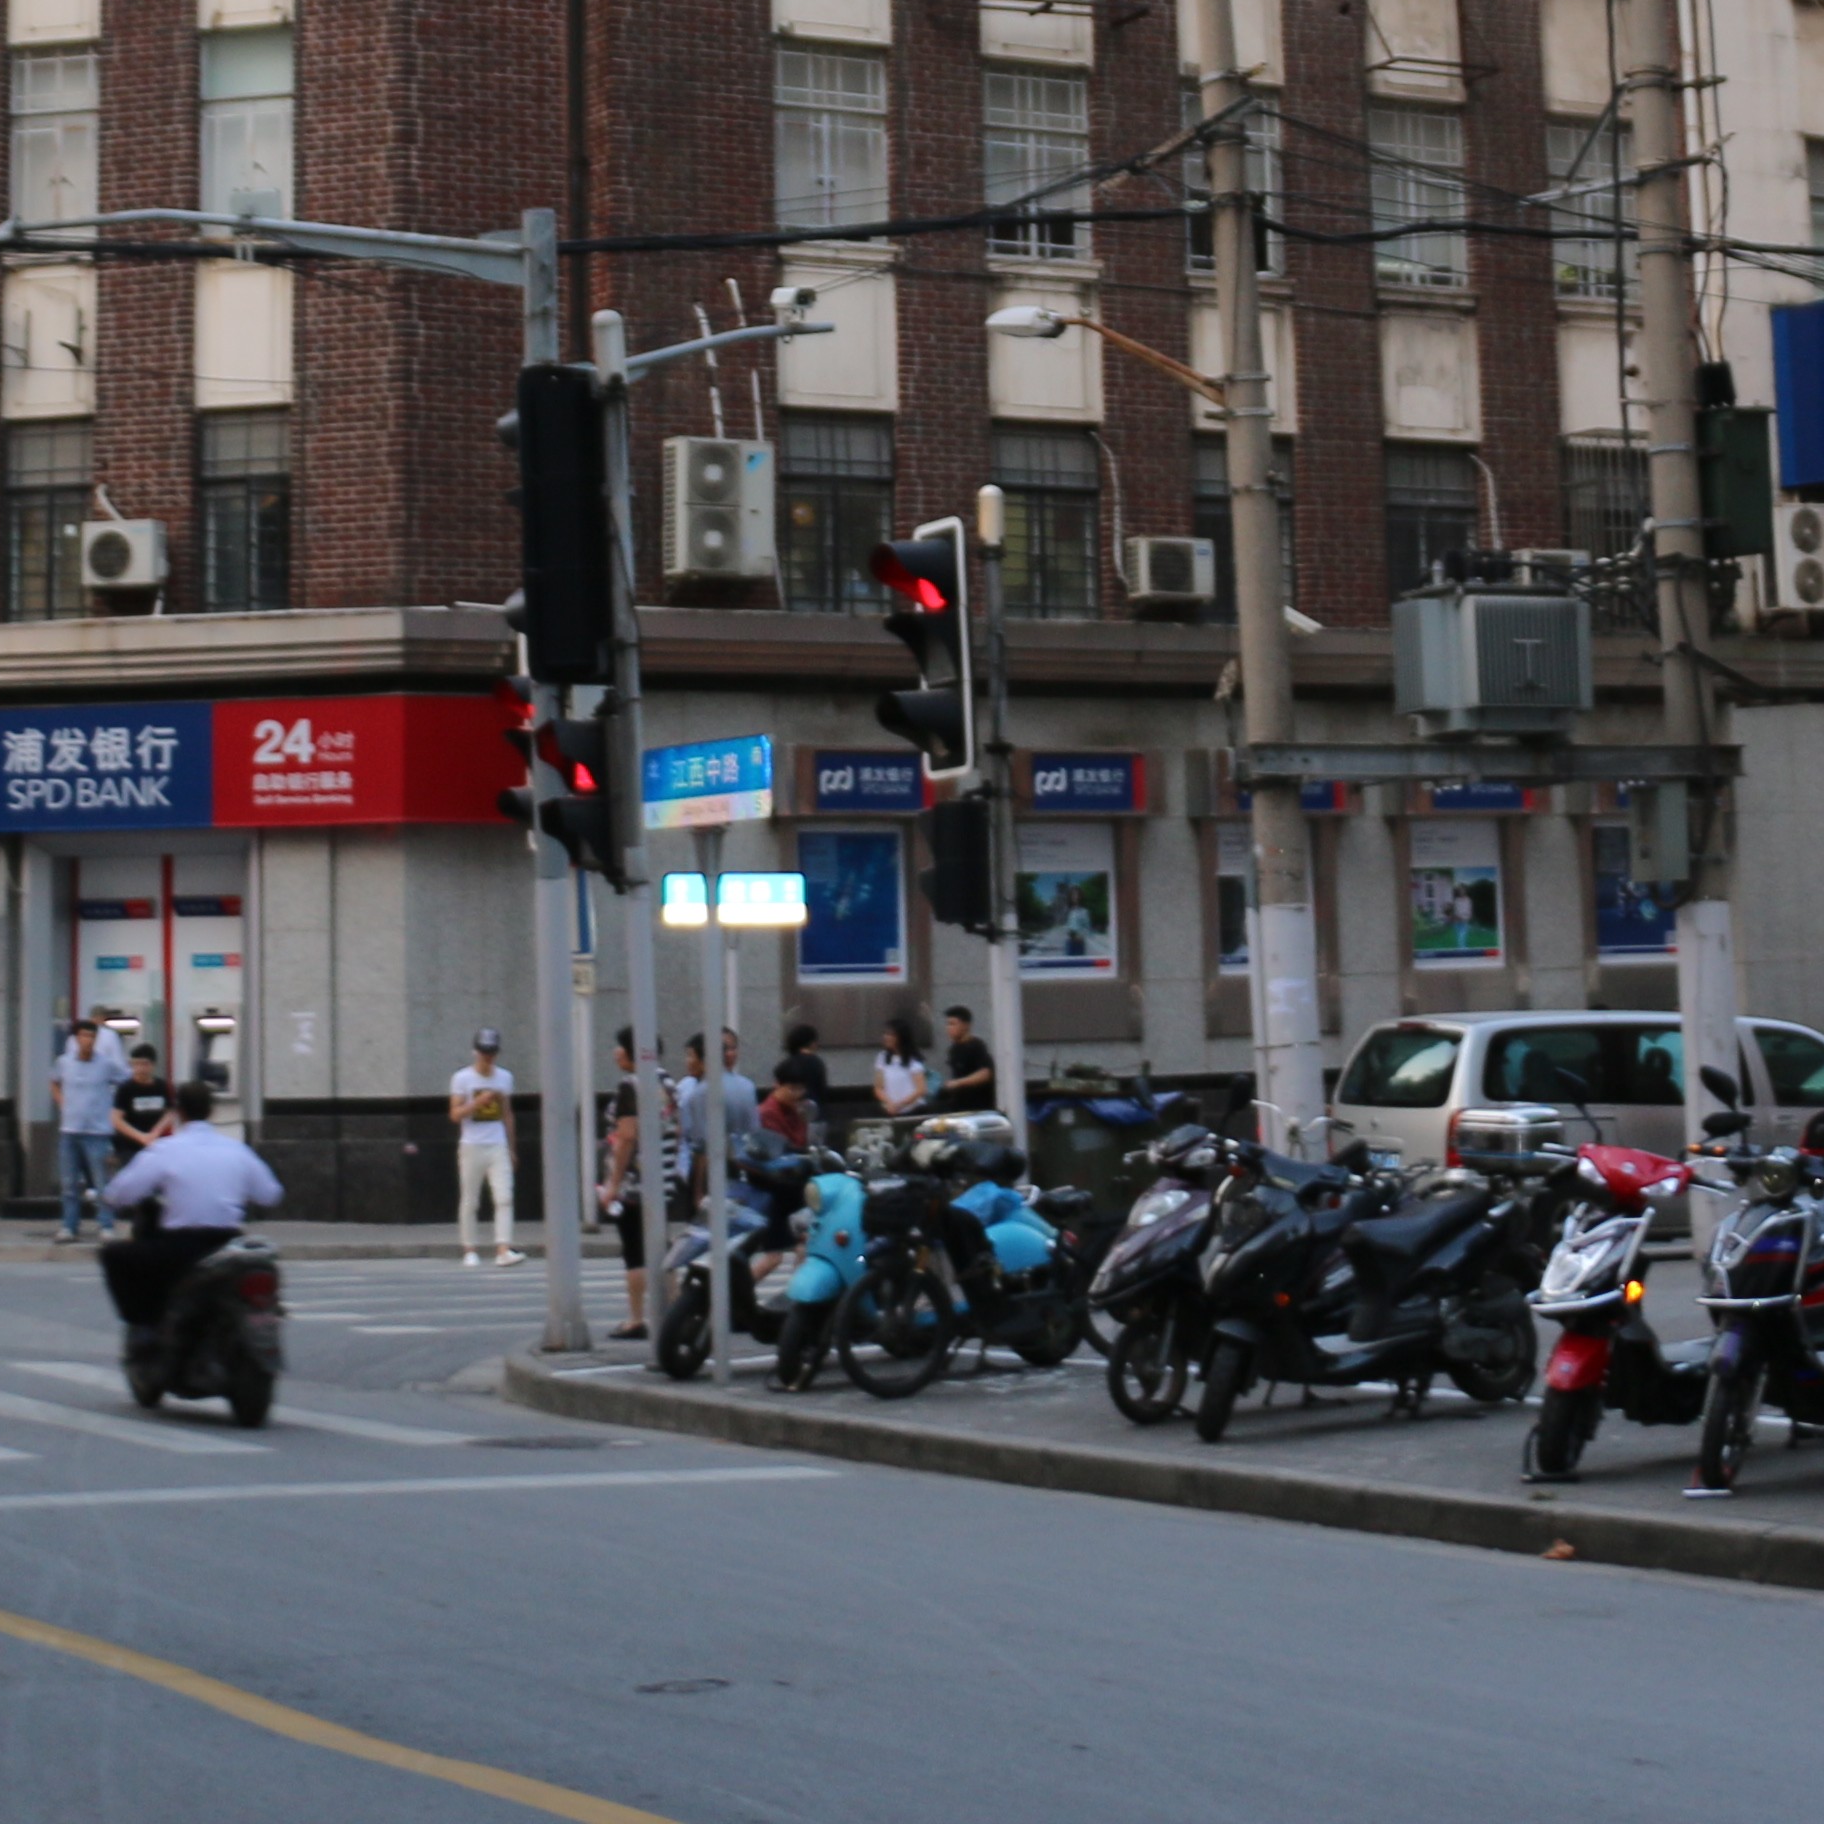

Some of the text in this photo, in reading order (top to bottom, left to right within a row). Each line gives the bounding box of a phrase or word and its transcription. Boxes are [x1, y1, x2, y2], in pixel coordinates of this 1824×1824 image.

[2, 723, 177, 774] 浦发银行
[253, 718, 316, 764] 24
[672, 752, 740, 789] 江西中路
[7, 775, 171, 811] SPD BANK
